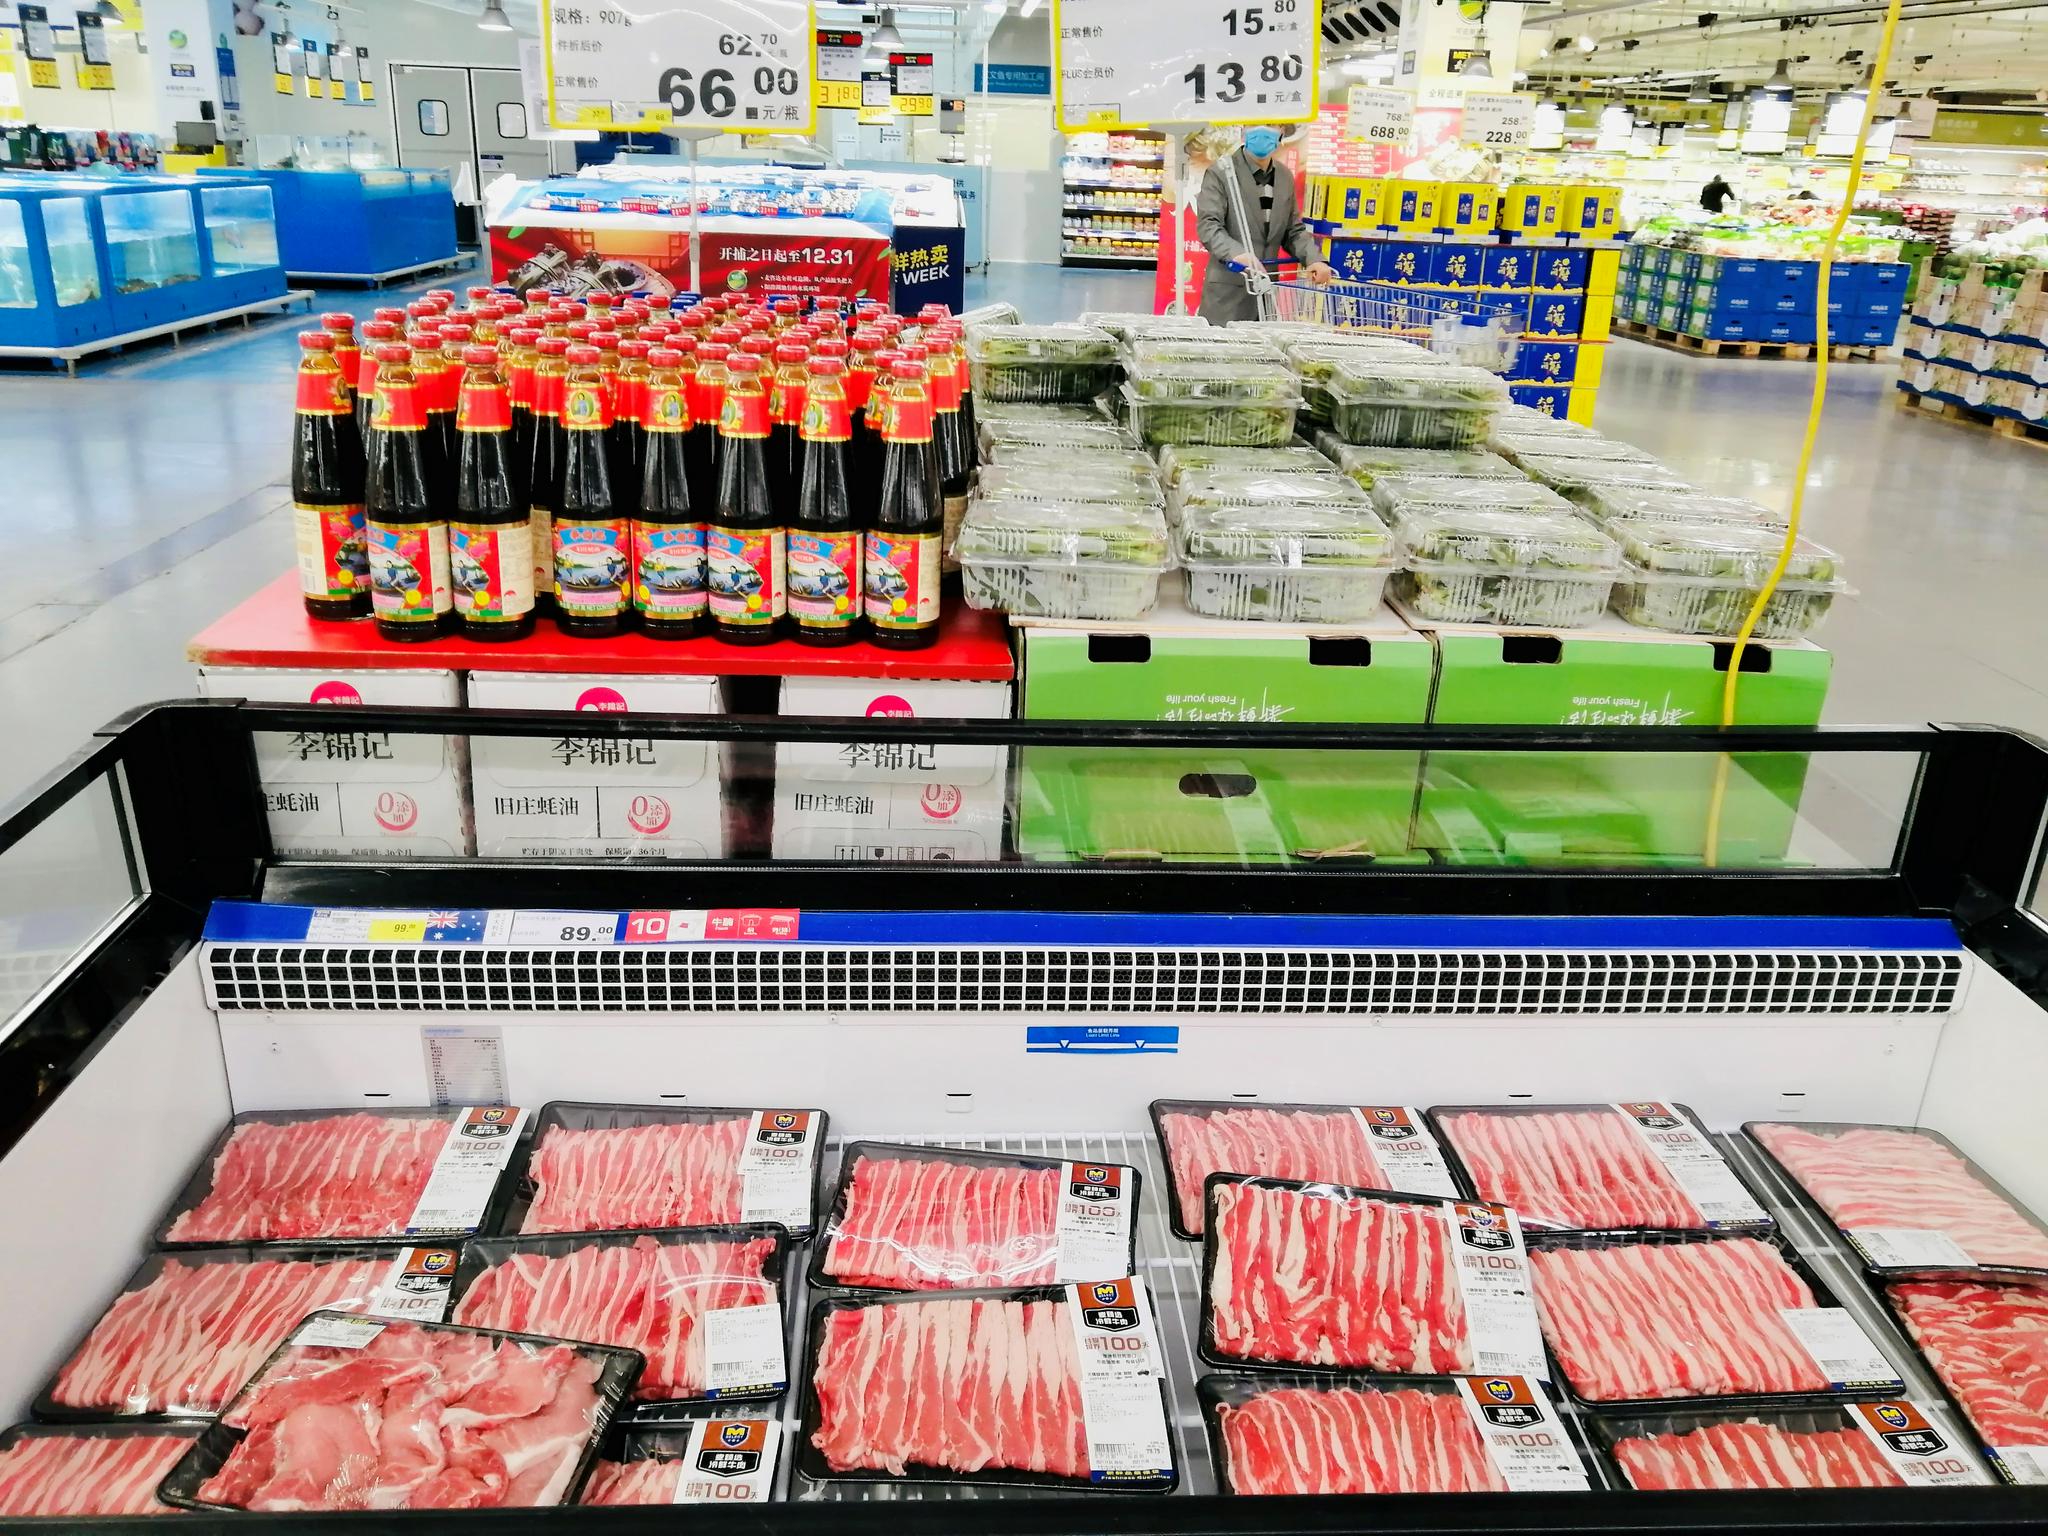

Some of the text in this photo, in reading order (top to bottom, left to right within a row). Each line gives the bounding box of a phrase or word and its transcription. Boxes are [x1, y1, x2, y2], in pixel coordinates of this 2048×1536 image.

[1061, 26, 1103, 39] 正常售价
[554, 75, 599, 89] 正常售价
[1184, 54, 1303, 104] 13.80
[762, 105, 799, 121] 元/瓶
[719, 246, 855, 266] 开捕之日起至12.31
[902, 264, 950, 285] WEEK
[1182, 693, 1206, 704] your
[1588, 695, 1612, 706] your
[287, 732, 394, 761] 李锦记
[551, 737, 657, 766] 李锦记
[838, 743, 937, 771] 李锦记
[494, 796, 579, 817] 旧庄蚝油
[794, 791, 874, 816] 旧庄蚝油
[560, 926, 613, 942] 89.00
[631, 917, 666, 935] 10
